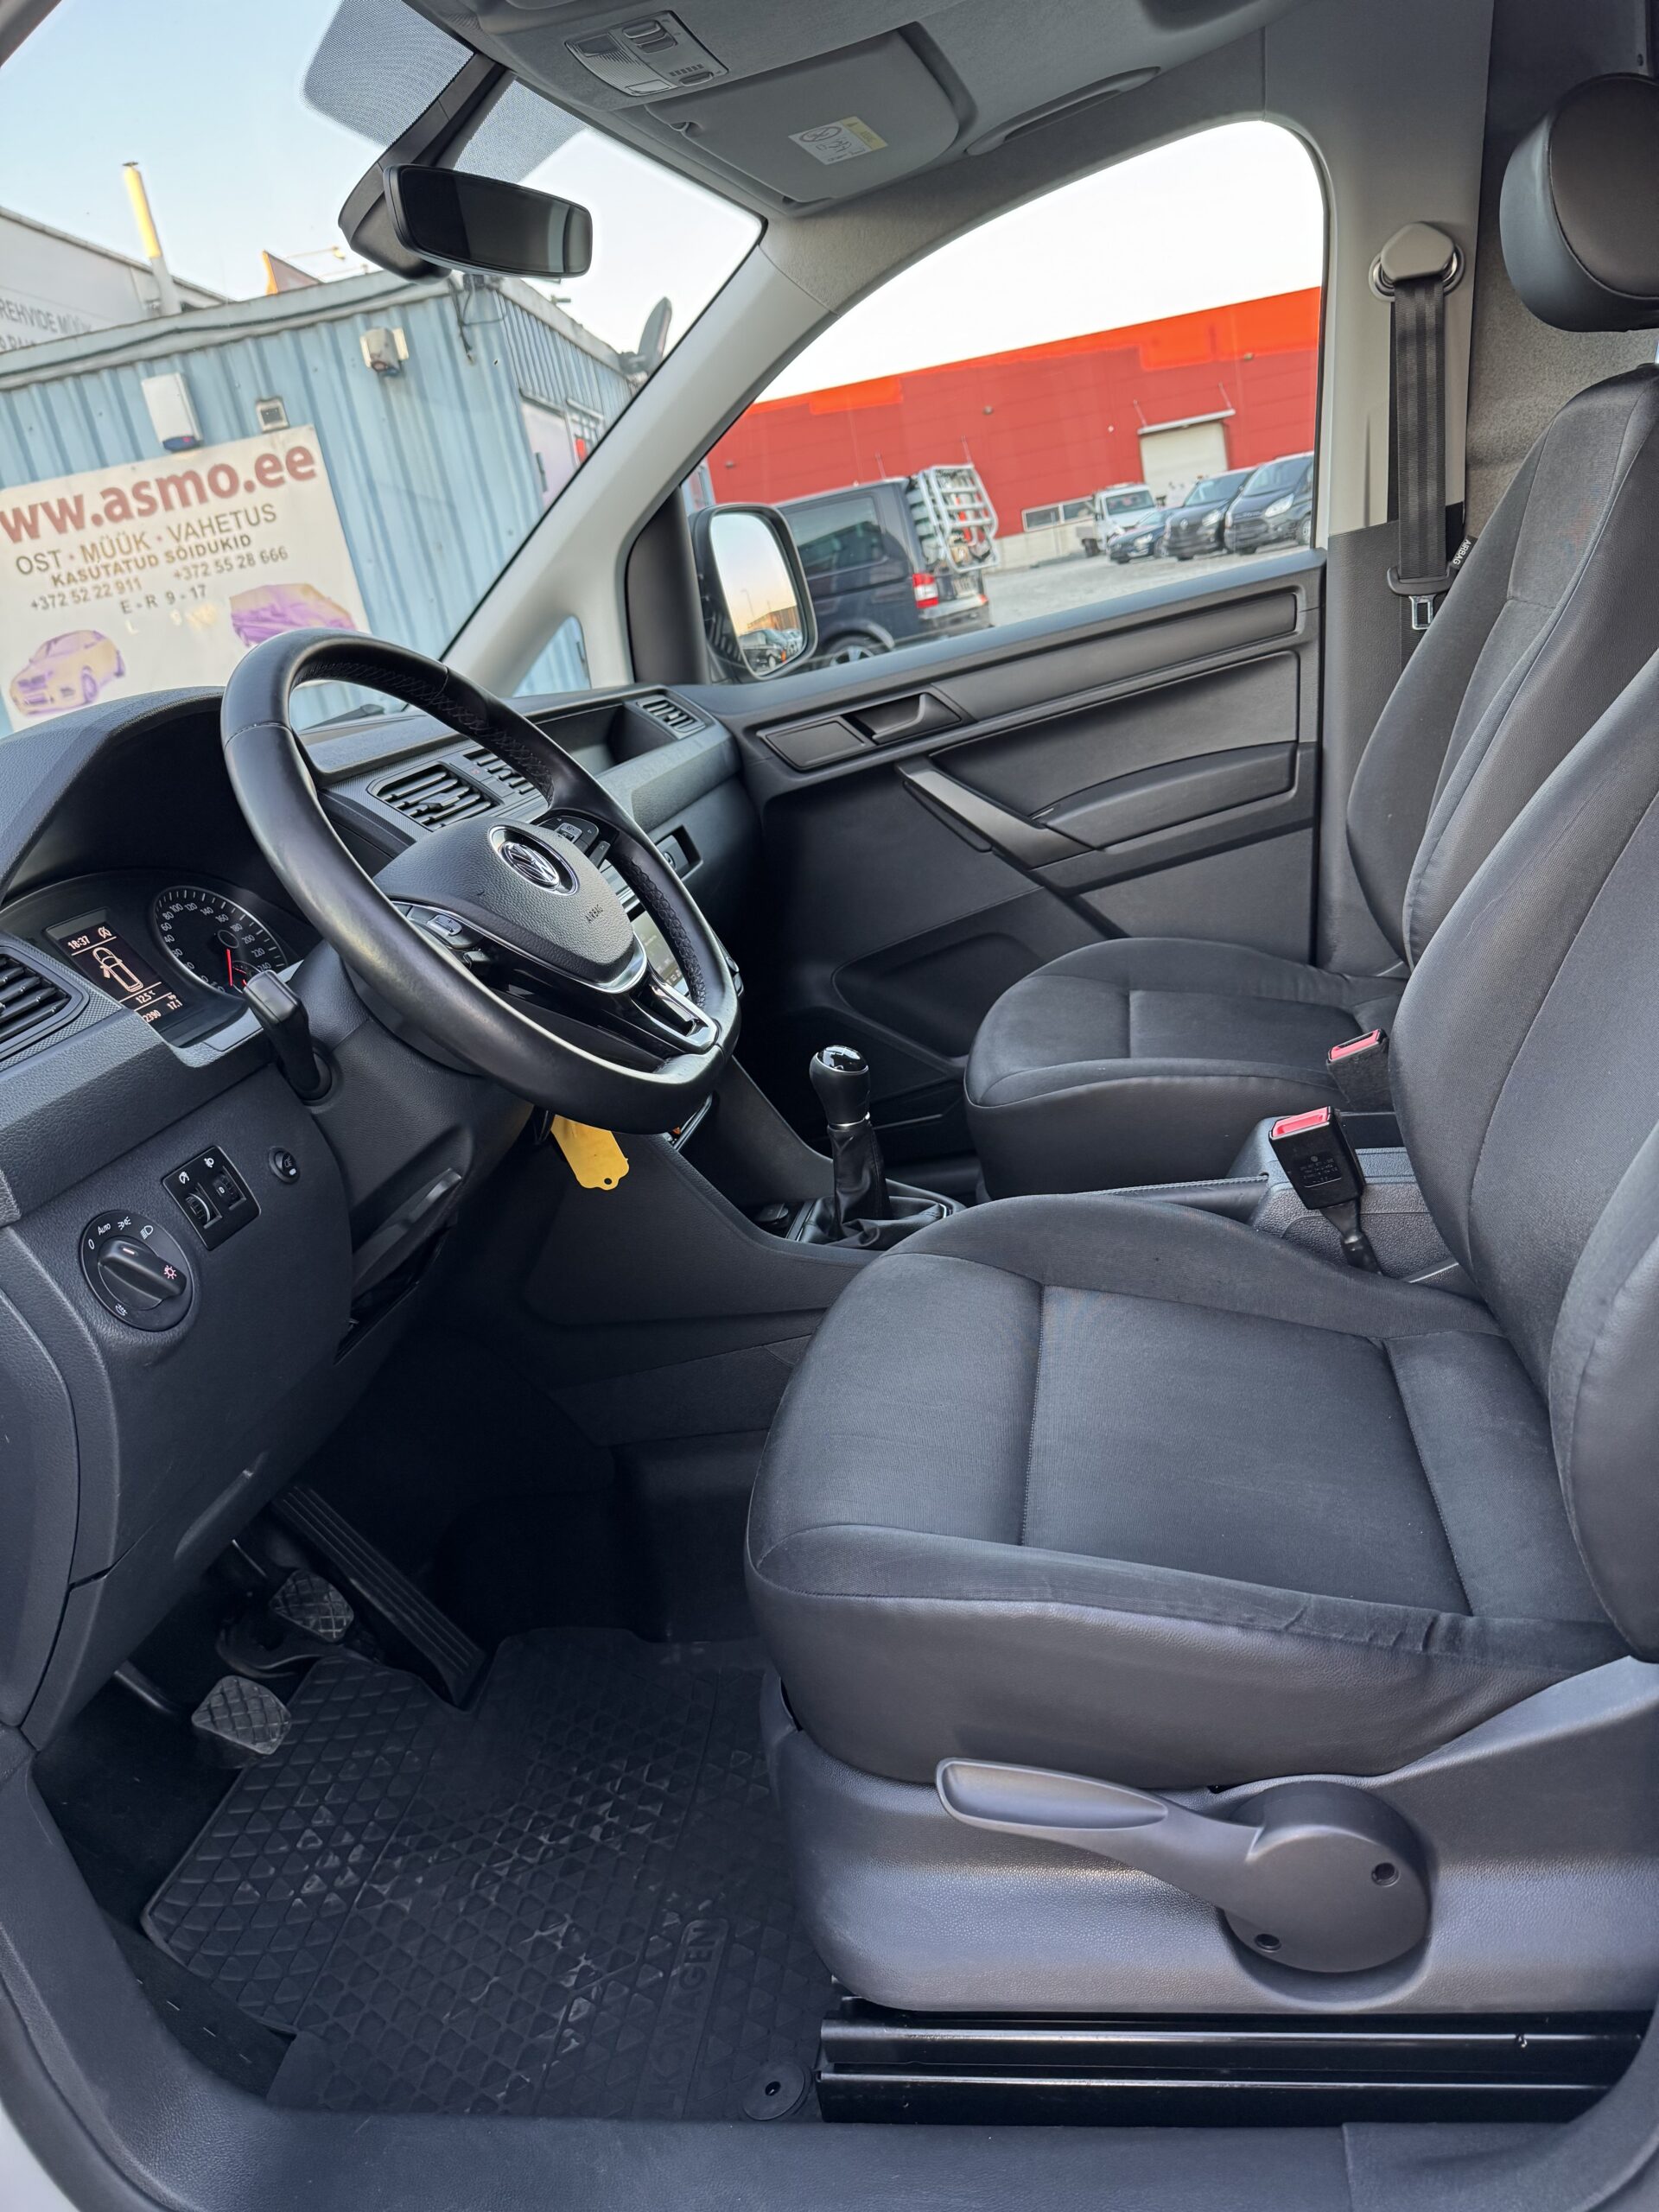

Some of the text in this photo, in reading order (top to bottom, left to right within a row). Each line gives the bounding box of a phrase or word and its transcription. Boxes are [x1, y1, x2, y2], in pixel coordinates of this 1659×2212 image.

[16, 503, 277, 575] OST MÜÜK VAHETUS
[1452, 538, 1471, 565] AIRBAG
[173, 563, 211, 581] +372
[237, 552, 256, 569] 28
[259, 546, 289, 564] 666
[51, 555, 159, 588] KASUTATUD
[30, 577, 143, 610] +372 52 22 911
[169, 903, 184, 912] 100
[184, 902, 198, 911] 120
[200, 906, 213, 916] 140
[162, 912, 174, 920] 80
[215, 914, 229, 923] 160
[161, 922, 173, 931] 60
[67, 935, 91, 950] 18:37
[164, 934, 175, 943] 40
[242, 935, 255, 944] 200
[251, 947, 265, 957] 220
